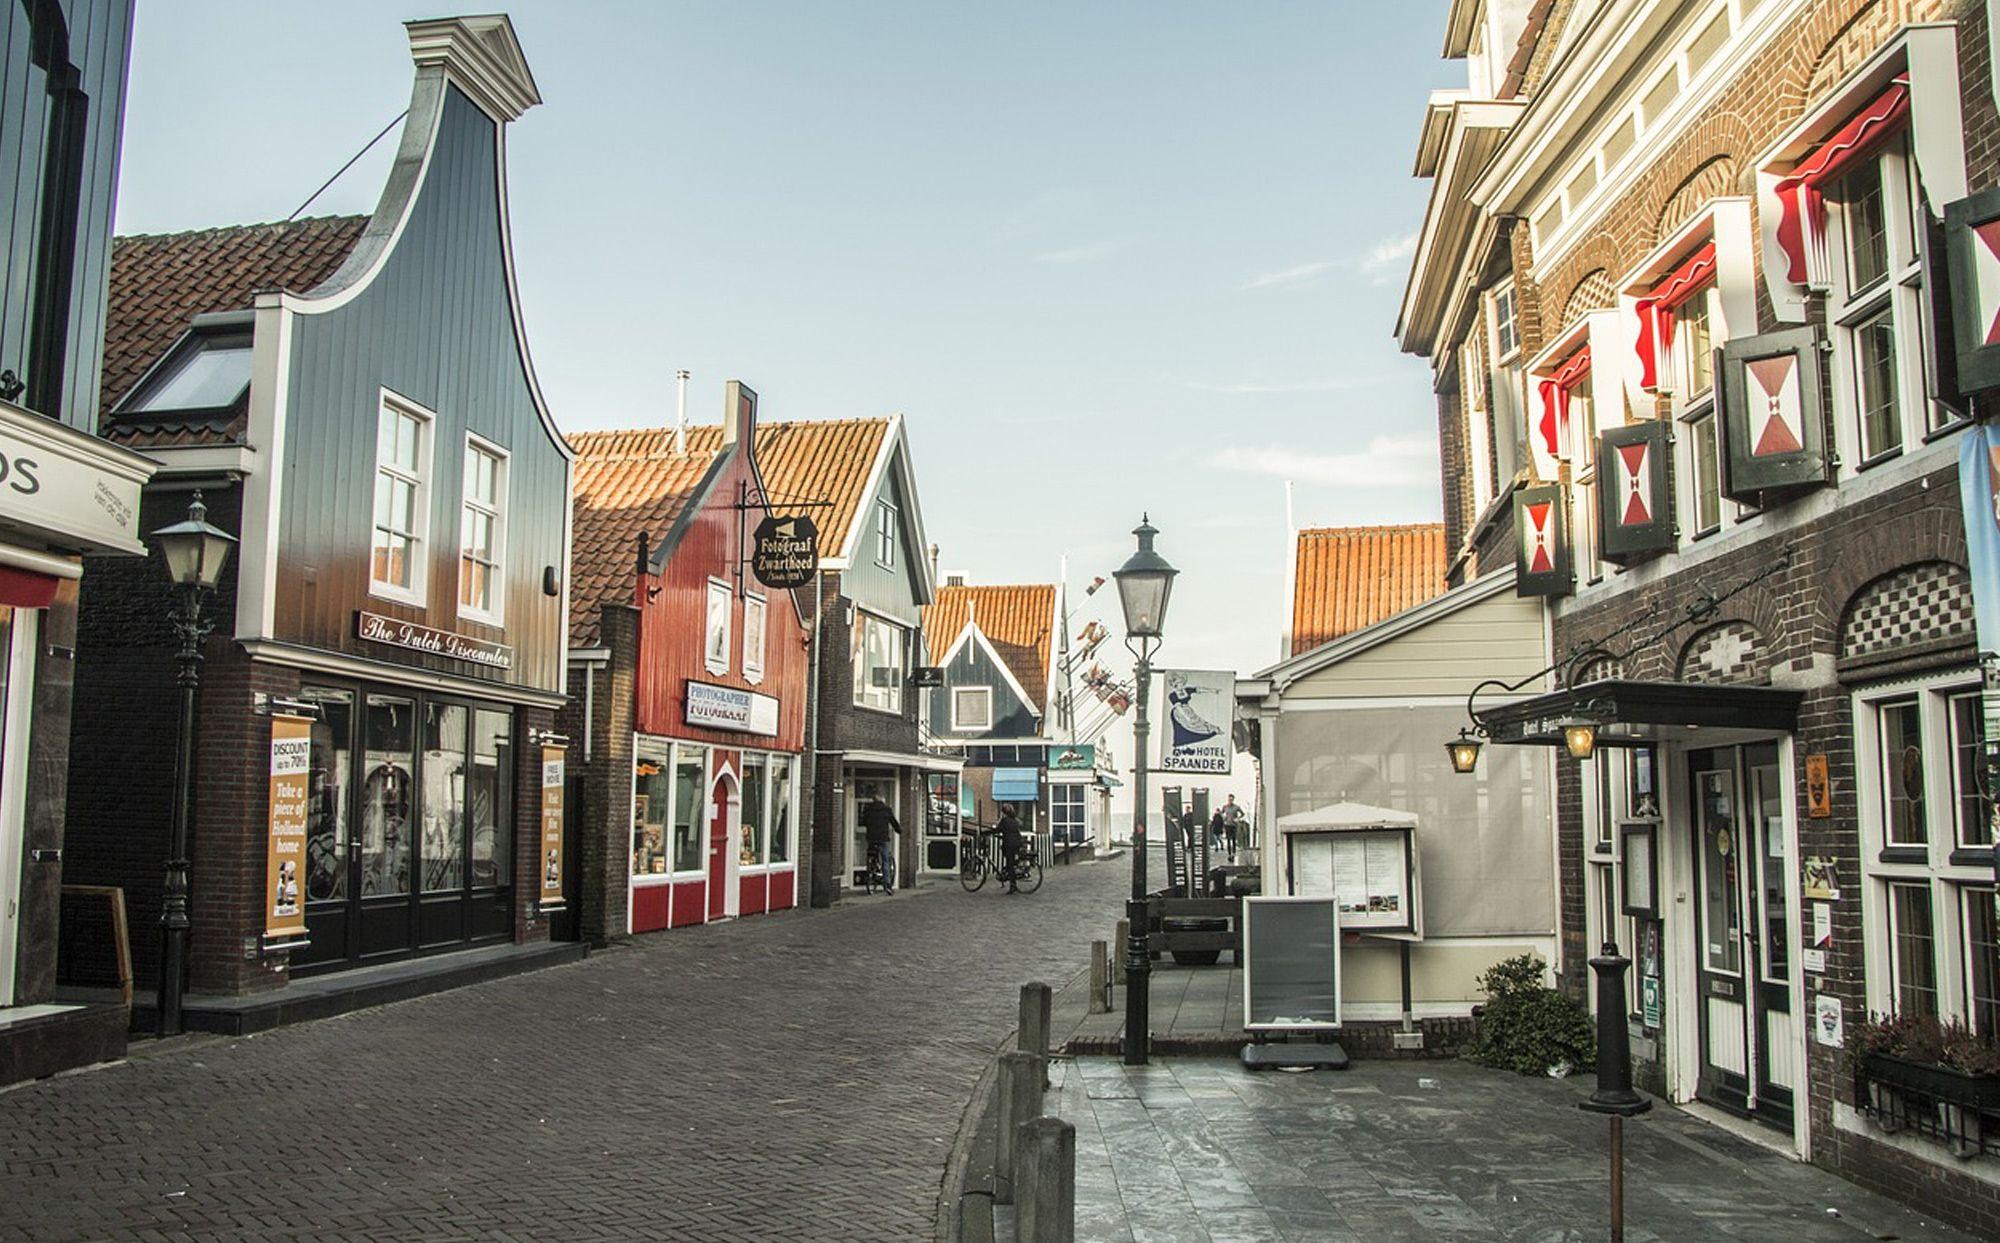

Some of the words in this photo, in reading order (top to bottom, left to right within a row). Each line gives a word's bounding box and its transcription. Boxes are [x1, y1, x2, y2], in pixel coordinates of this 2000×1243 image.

[761, 536, 812, 556] Fotograaf
[758, 554, 813, 570] Zwarthoed
[364, 616, 397, 642] The
[399, 623, 443, 652] Dutch
[446, 633, 510, 666] Discounter
[690, 685, 750, 706] PHOTOGRAPHER
[274, 742, 309, 756] DISCOUNT
[1196, 747, 1226, 757] HOTEL
[291, 755, 306, 768] 70%
[1164, 757, 1226, 770] SPAANDER
[277, 783, 296, 798] Take
[297, 786, 304, 799] a
[273, 801, 294, 820] piece
[295, 799, 306, 819] of
[272, 819, 306, 836] Holland
[276, 838, 299, 853] home
